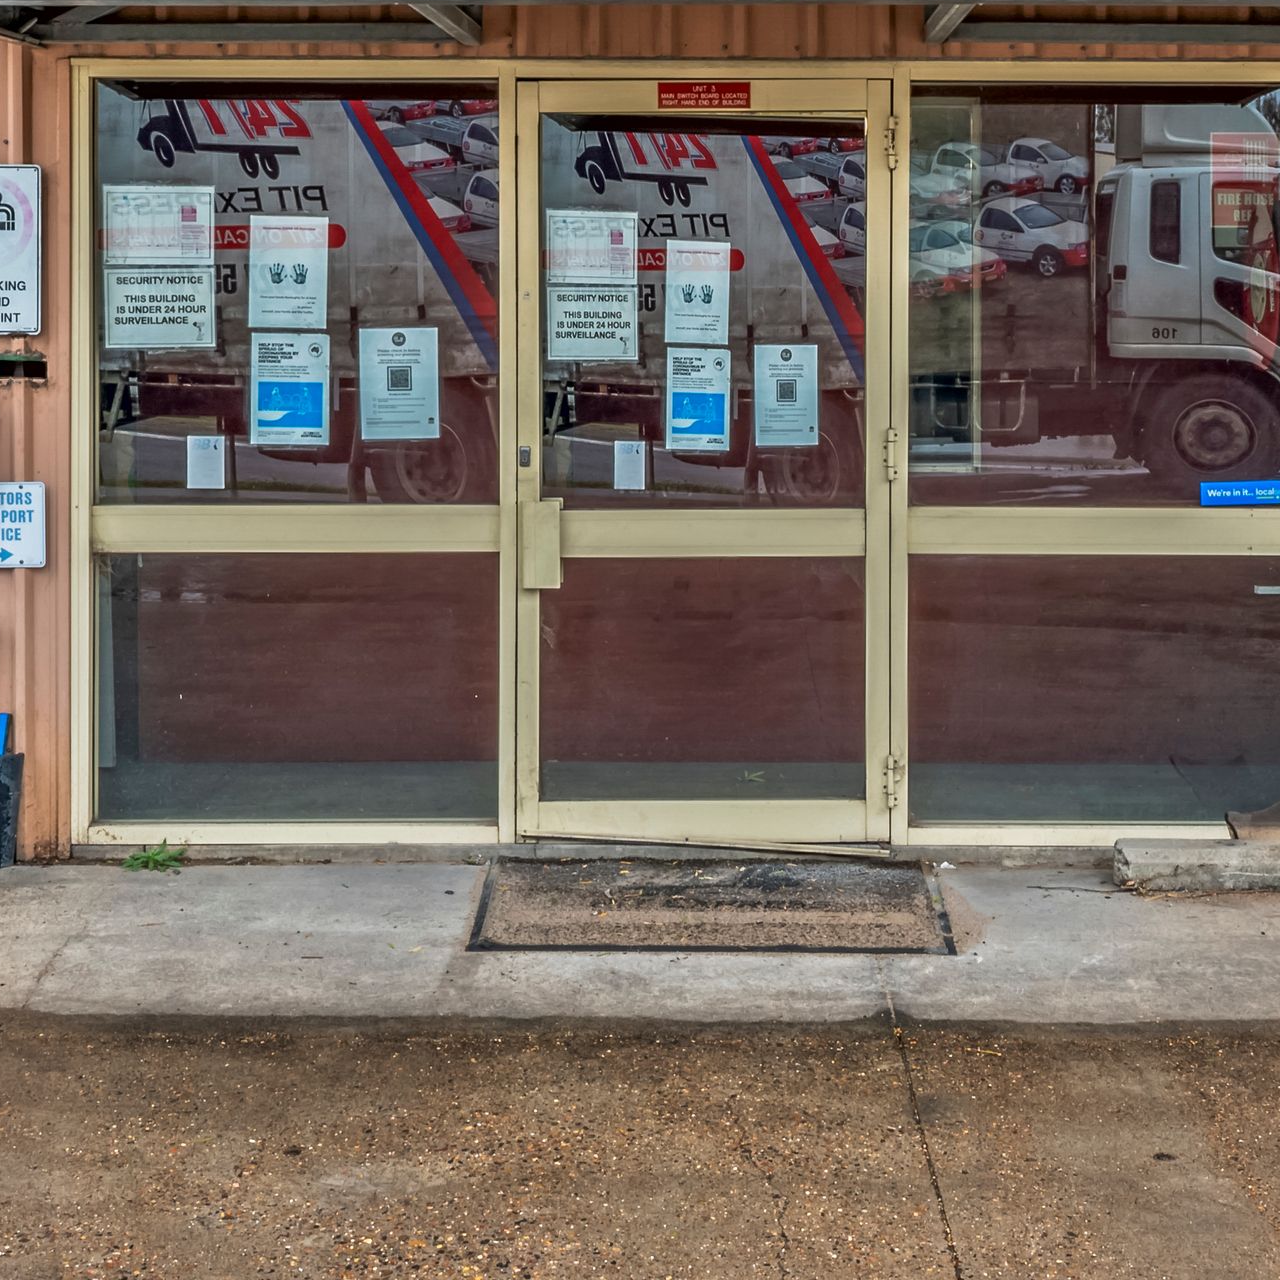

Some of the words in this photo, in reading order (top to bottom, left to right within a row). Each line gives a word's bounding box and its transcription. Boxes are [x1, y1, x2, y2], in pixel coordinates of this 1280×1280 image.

[1217, 192, 1241, 206] FIRE
[1244, 192, 1274, 206] HOSE
[116, 276, 165, 285] SECURITY
[166, 276, 204, 285] NOTICE
[124, 294, 147, 303] THIS
[148, 294, 196, 303] BUILDING
[556, 294, 597, 302] SECURITY
[598, 294, 629, 302] NOTICE
[116, 305, 126, 314] IS
[128, 305, 162, 314] UNDER
[164, 305, 176, 314] 24
[178, 305, 207, 313] HOUR
[563, 311, 582, 319] THIS
[583, 311, 622, 319] BUILDING
[114, 316, 189, 325] SURVEILLANCE
[557, 321, 565, 329] IS
[566, 321, 595, 329] UNDER
[596, 321, 606, 329] 24
[607, 321, 631, 329] HOUR
[555, 331, 617, 339] SURVEILLANCE
[1207, 489, 1231, 497] We're
[1232, 488, 1241, 496] in
